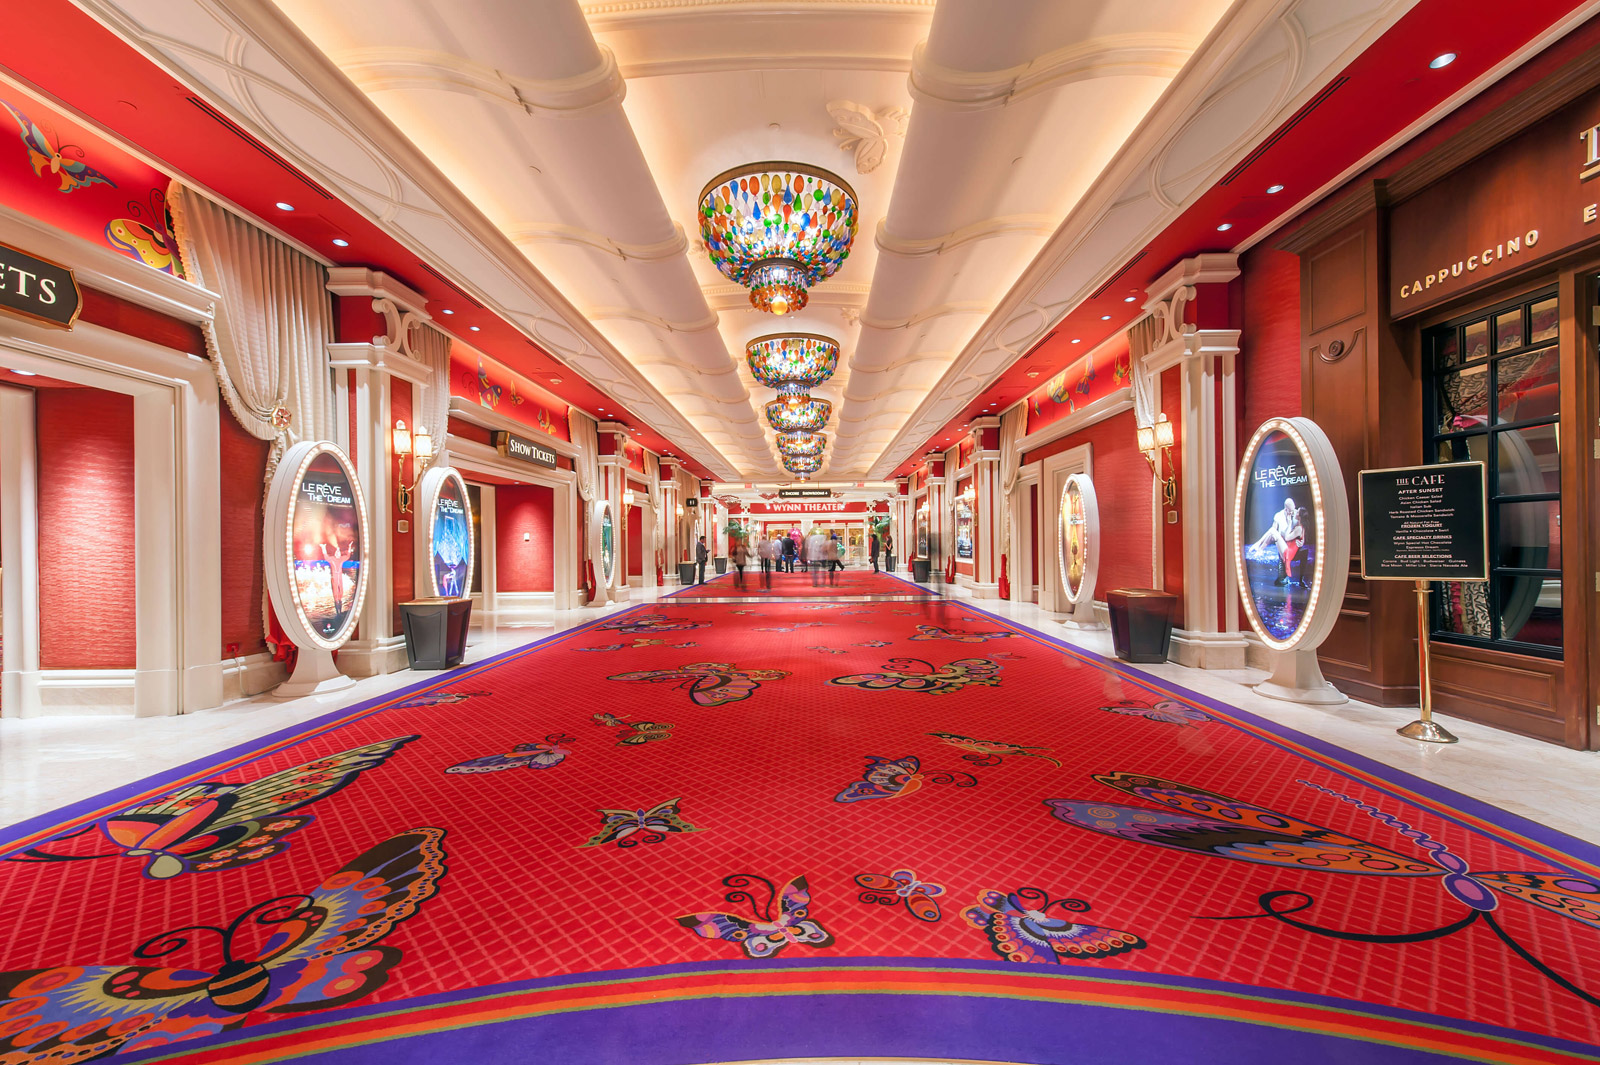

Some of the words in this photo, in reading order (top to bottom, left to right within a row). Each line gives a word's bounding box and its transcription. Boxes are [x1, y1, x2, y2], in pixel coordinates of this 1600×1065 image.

[1400, 229, 1540, 299] CAPPUCCINO
[510, 439, 532, 456] SHOW
[531, 446, 555, 464] TICKETS
[1254, 469, 1268, 480] LE
[1411, 474, 1445, 486] CAFE
[302, 482, 316, 493] LE
[1259, 479, 1276, 488] THE
[1280, 475, 1308, 486] DREAM
[307, 492, 323, 502] THE
[327, 494, 351, 504] DREAM
[773, 503, 801, 511] WYNN
[803, 503, 843, 511] THEATER
